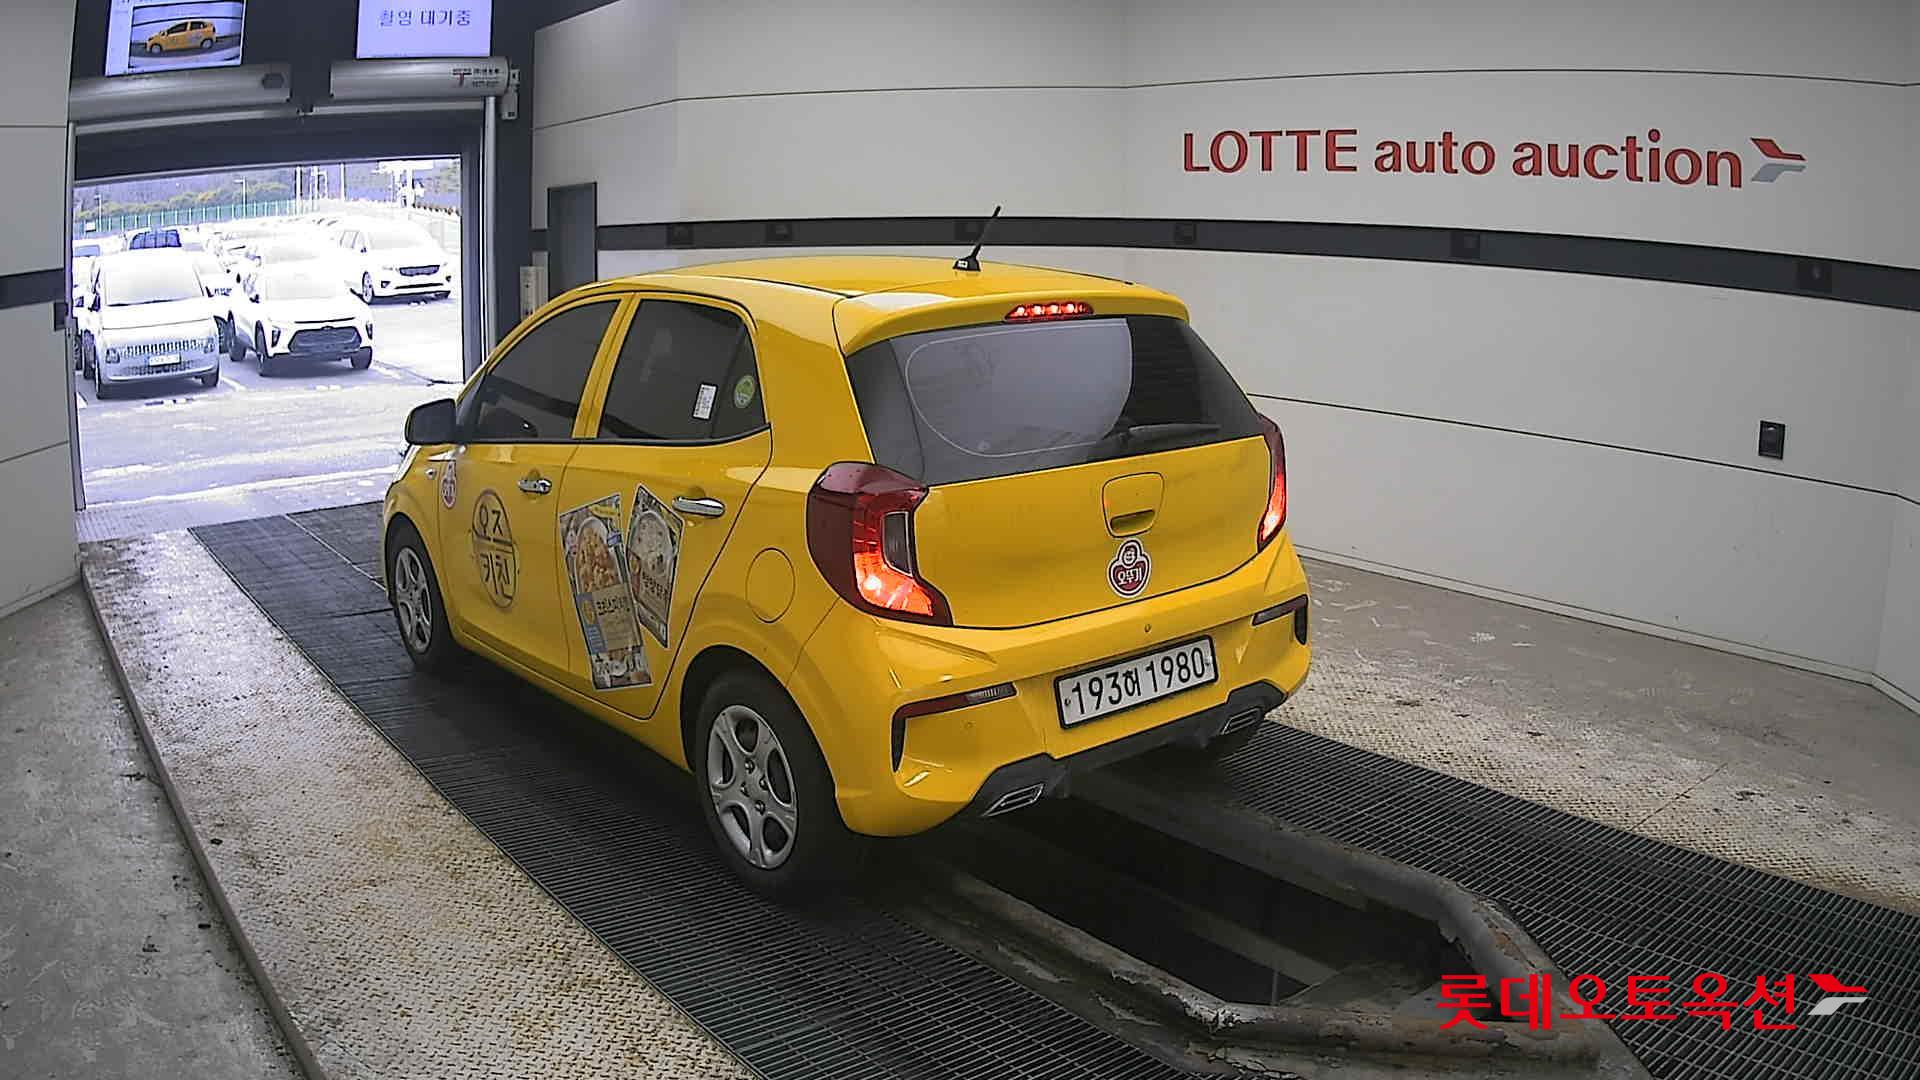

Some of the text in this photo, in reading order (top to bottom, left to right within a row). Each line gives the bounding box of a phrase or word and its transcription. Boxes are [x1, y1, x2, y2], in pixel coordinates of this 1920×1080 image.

[420, 9, 470, 26] 대기중
[1184, 129, 1742, 188] LOTTE auto auction
[479, 552, 514, 601] 키친
[1117, 567, 1142, 585] 오뚜기
